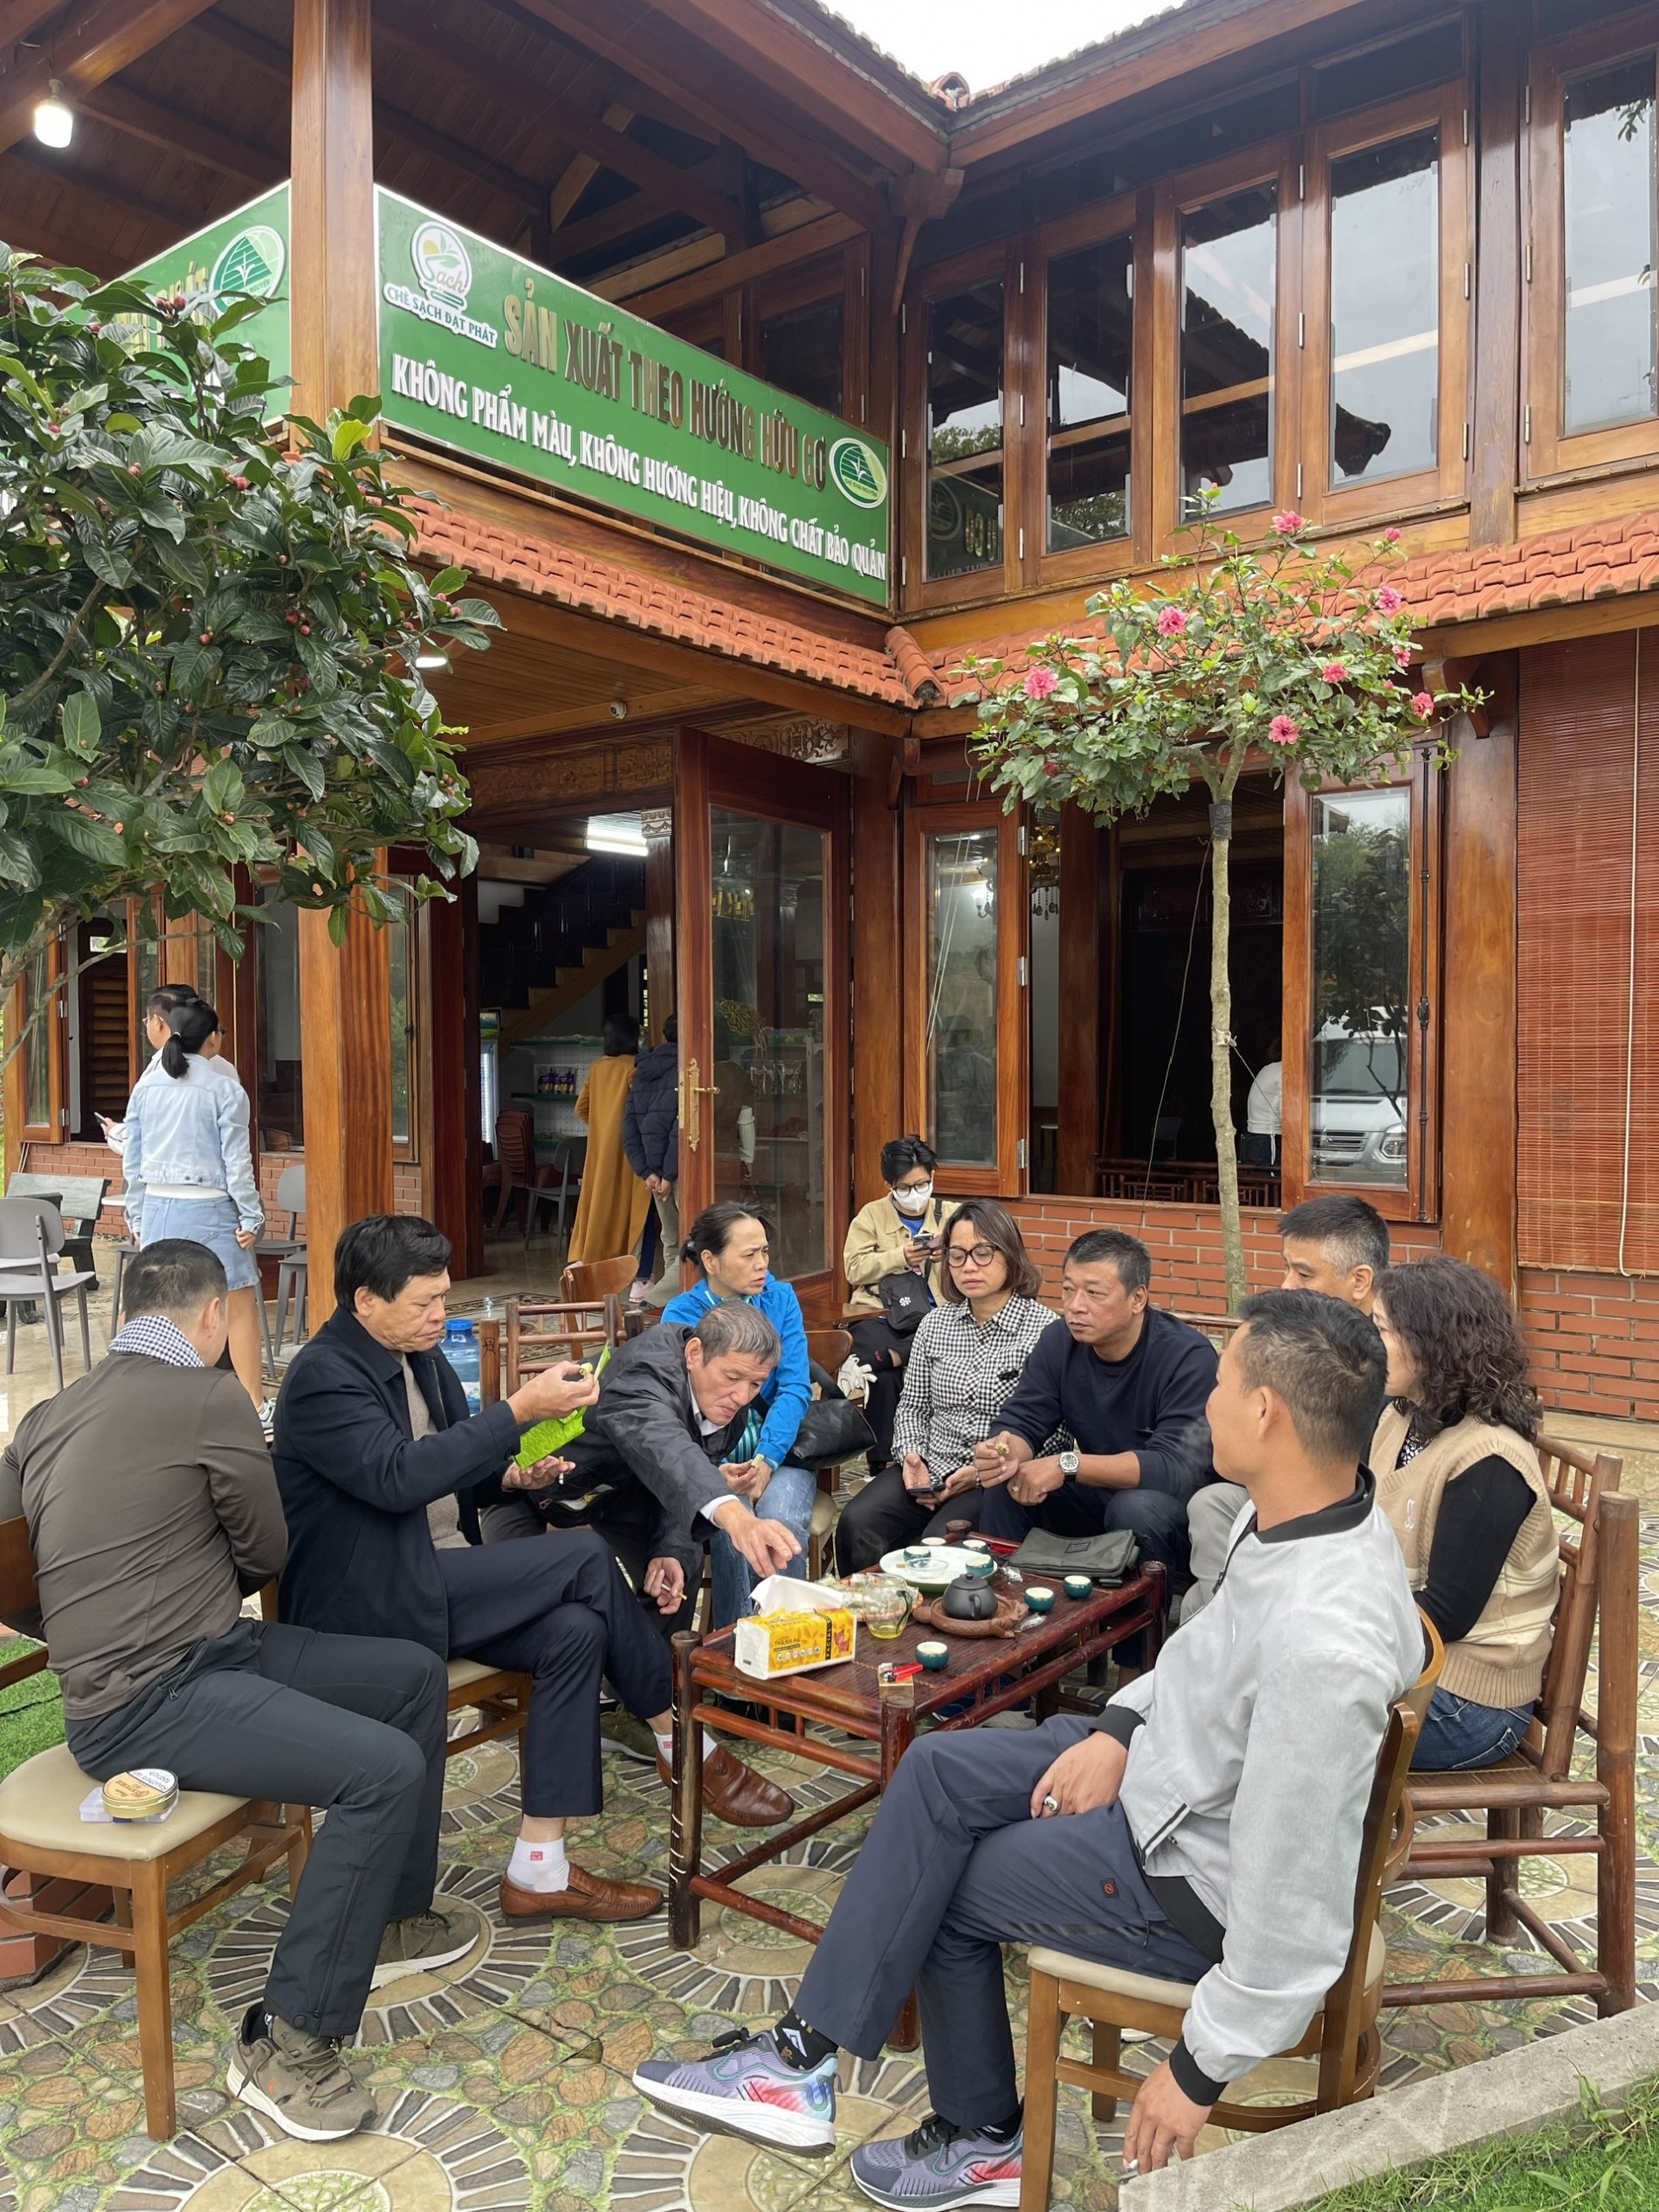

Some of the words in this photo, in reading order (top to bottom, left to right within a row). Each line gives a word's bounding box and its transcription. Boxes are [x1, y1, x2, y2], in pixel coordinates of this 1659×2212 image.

[387, 286, 410, 306] CHÈ
[412, 298, 442, 320] SẠCH
[445, 312, 465, 330] ĐẠT
[469, 322, 495, 344] PHÁT
[505, 278, 557, 372] SẢN
[565, 321, 623, 401] XUẤT
[629, 349, 684, 428] THEO
[690, 378, 754, 460] HƯỚNG
[761, 409, 798, 478] HỮU
[802, 434, 826, 490] CƠ
[392, 353, 468, 418] KHÔNG
[472, 384, 527, 442] PHẨM
[531, 410, 577, 467] MÀU,
[580, 431, 640, 485] KHÔNG
[643, 457, 698, 507] HƯƠNG
[700, 479, 737, 529] HIỆU,
[738, 497, 788, 542] KHÔNG
[790, 518, 823, 556] CHẤT
[825, 524, 849, 566] BẢO
[851, 538, 885, 581] QUẢN
